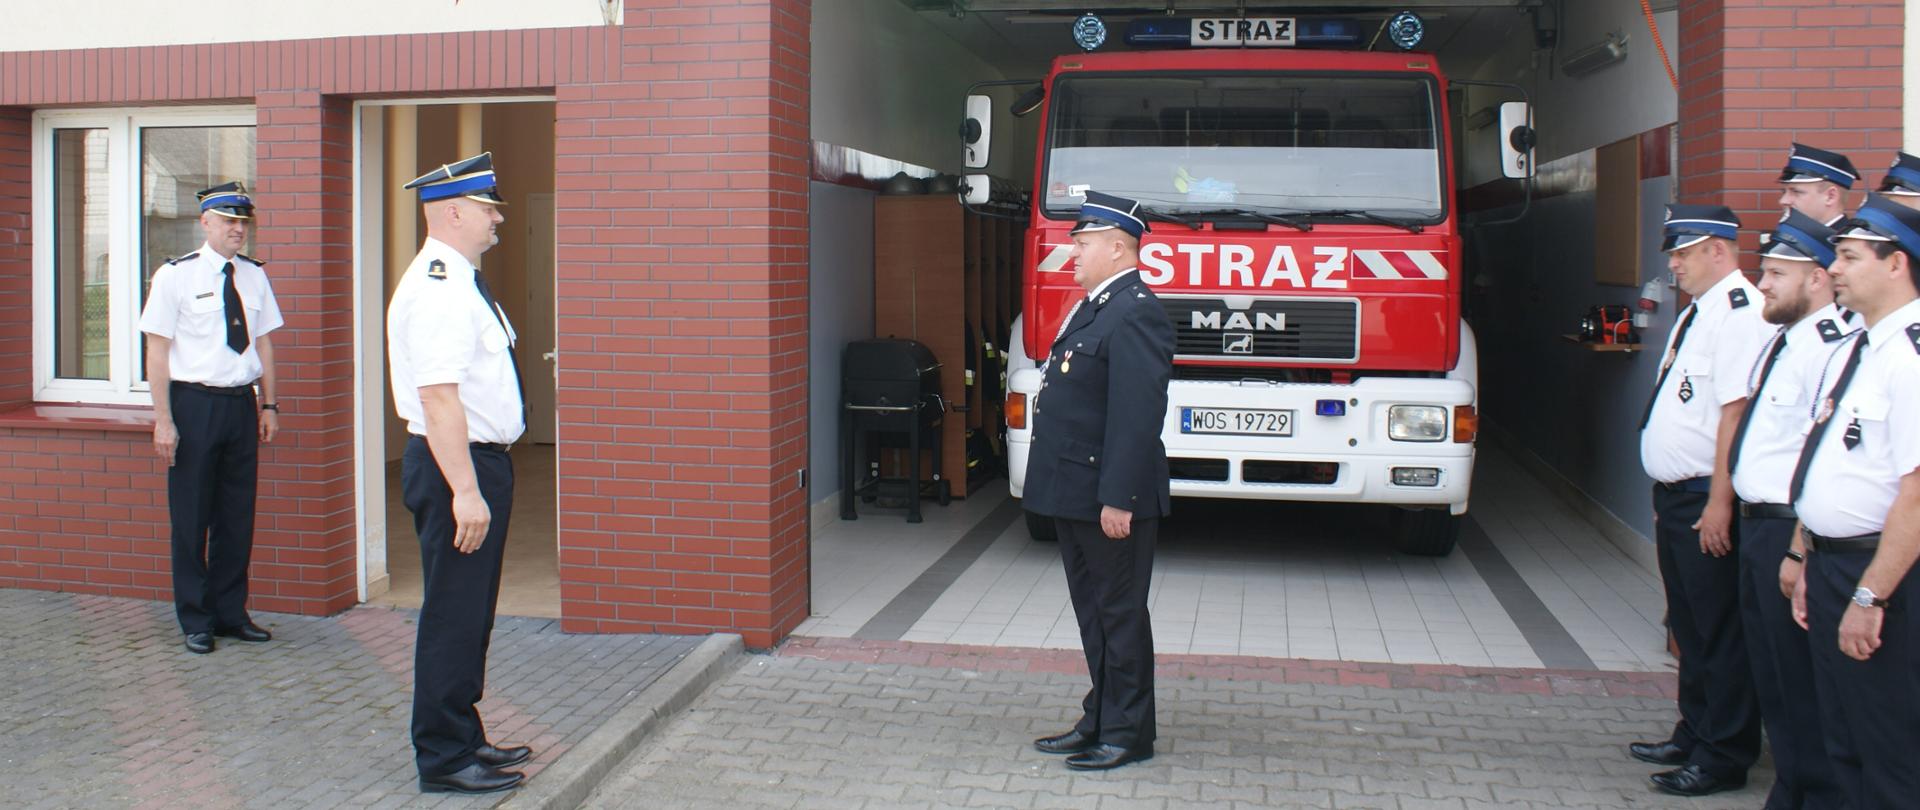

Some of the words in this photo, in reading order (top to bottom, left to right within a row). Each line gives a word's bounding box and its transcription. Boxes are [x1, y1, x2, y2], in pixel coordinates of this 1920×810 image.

[1191, 310, 1286, 331] MAN
[1193, 411, 1227, 430] WOS
[1235, 412, 1288, 432] 19729
